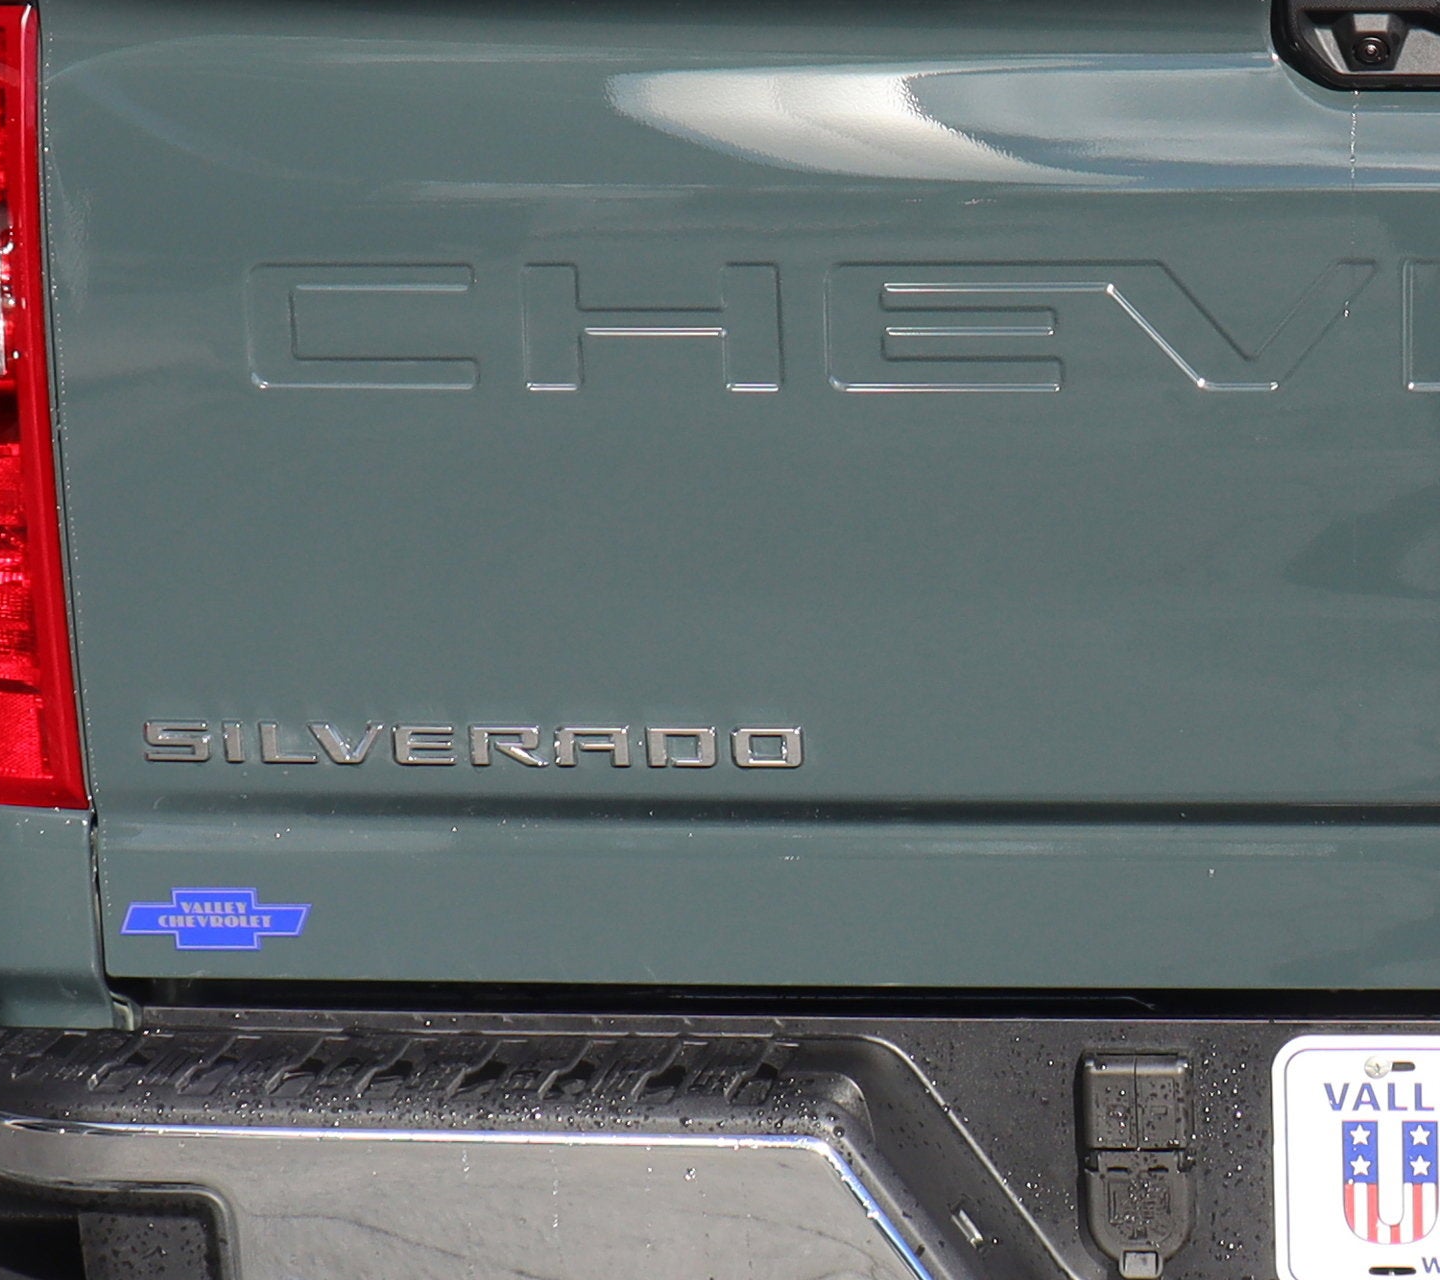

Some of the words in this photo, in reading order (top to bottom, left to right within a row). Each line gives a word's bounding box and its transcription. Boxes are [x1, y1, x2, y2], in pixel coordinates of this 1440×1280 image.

[142, 720, 804, 769] SILVERADO
[180, 901, 247, 914] VALLEY
[158, 914, 272, 928] CHEVROLET
